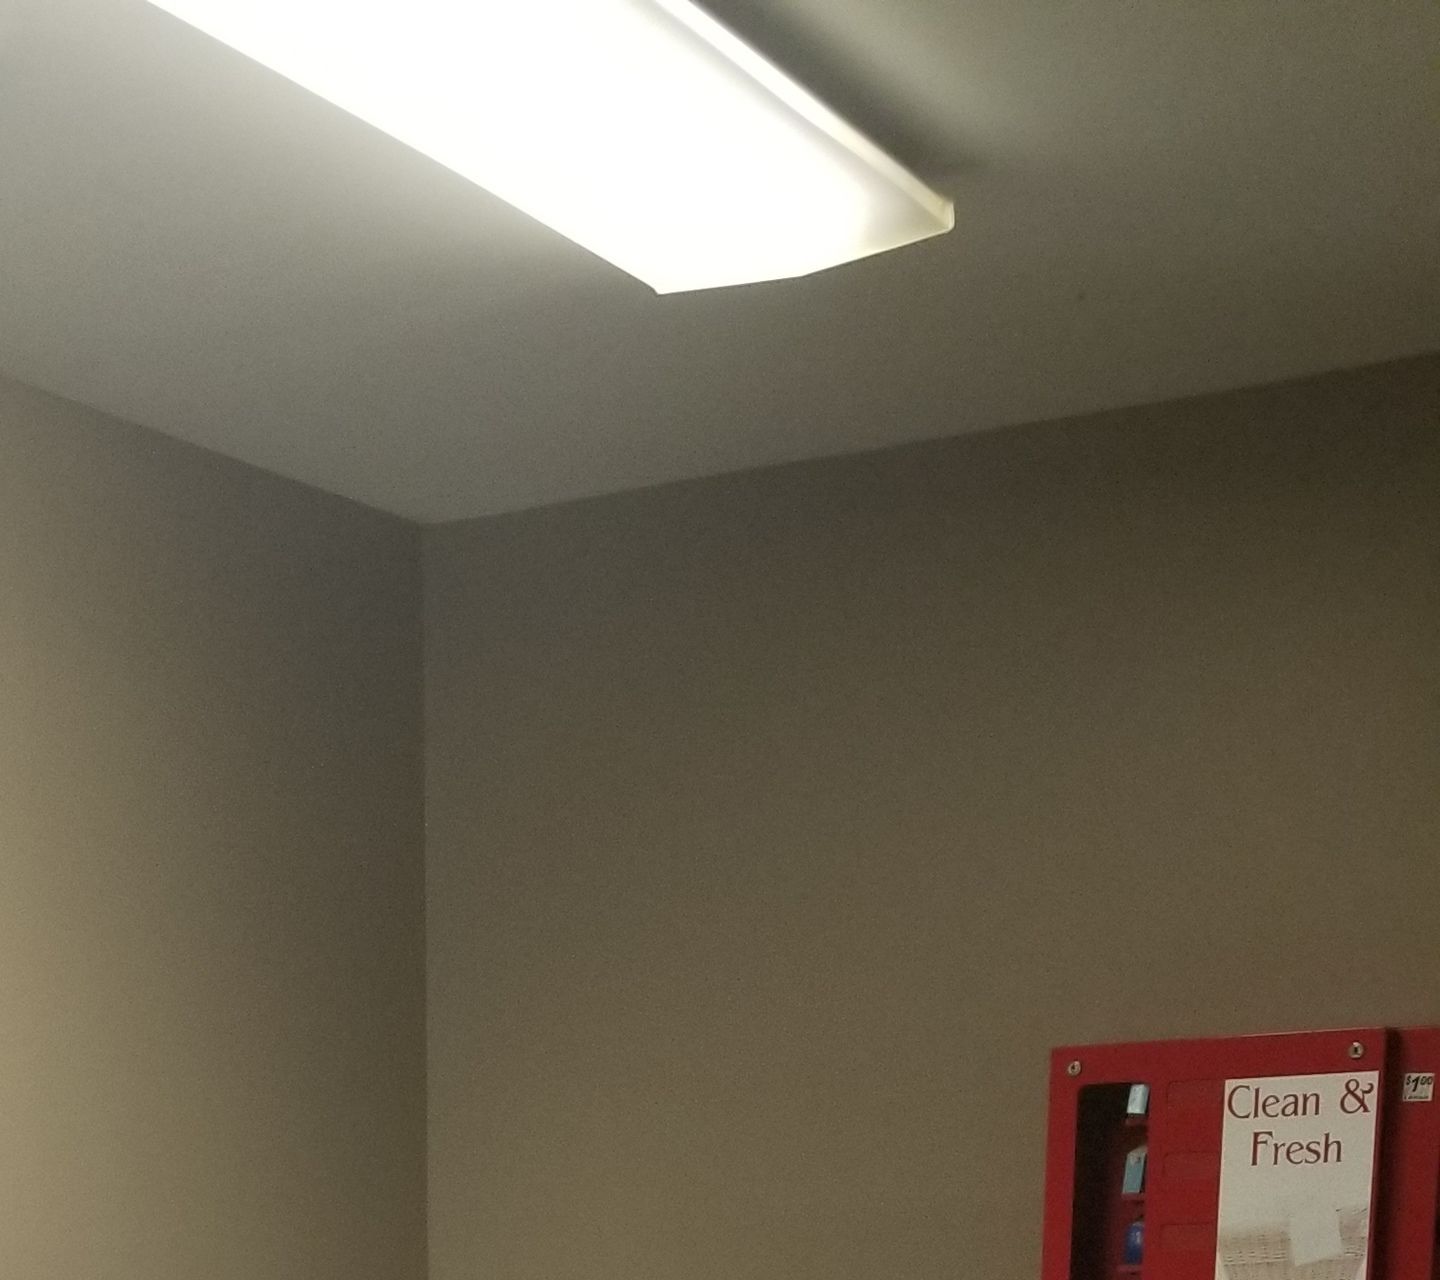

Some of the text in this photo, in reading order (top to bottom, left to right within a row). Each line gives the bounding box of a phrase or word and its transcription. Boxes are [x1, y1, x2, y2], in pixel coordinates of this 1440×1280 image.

[1228, 1078, 1374, 1119] Clean &
[1251, 1131, 1342, 1166] Fresh
